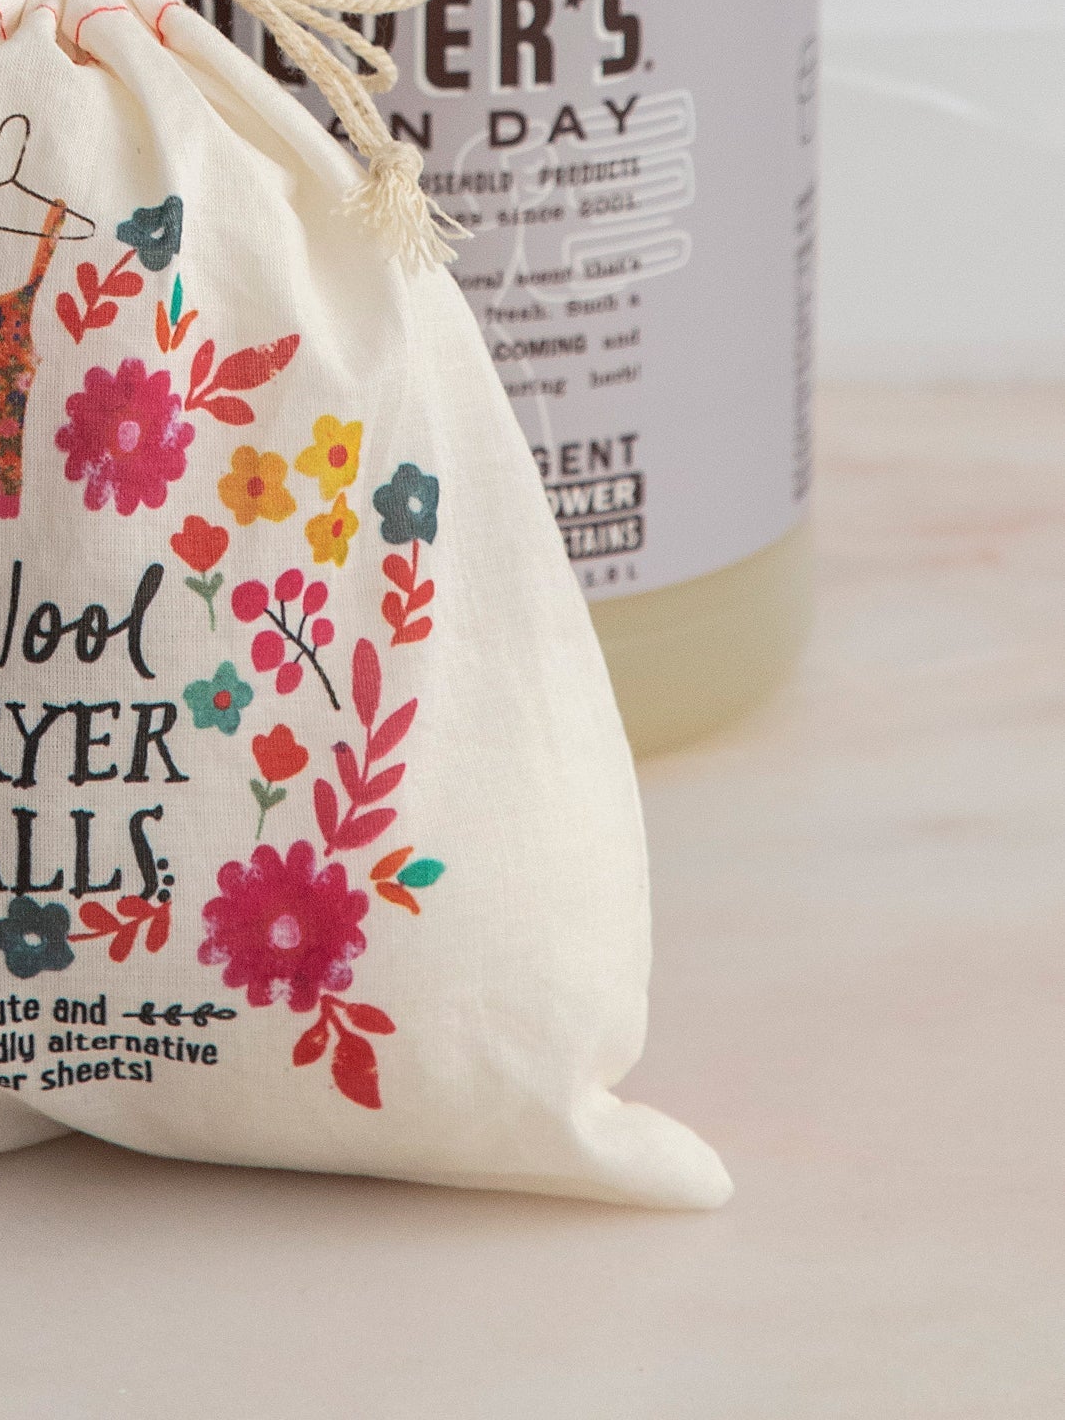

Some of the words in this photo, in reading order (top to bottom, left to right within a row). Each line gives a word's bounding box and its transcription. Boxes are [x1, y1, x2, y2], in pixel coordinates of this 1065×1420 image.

[489, 94, 641, 148] DAY
[491, 332, 588, 362] COMING
[602, 328, 641, 350] and
[544, 478, 635, 517] OWER
[53, 994, 107, 1026] and
[48, 1031, 219, 1066] alternative
